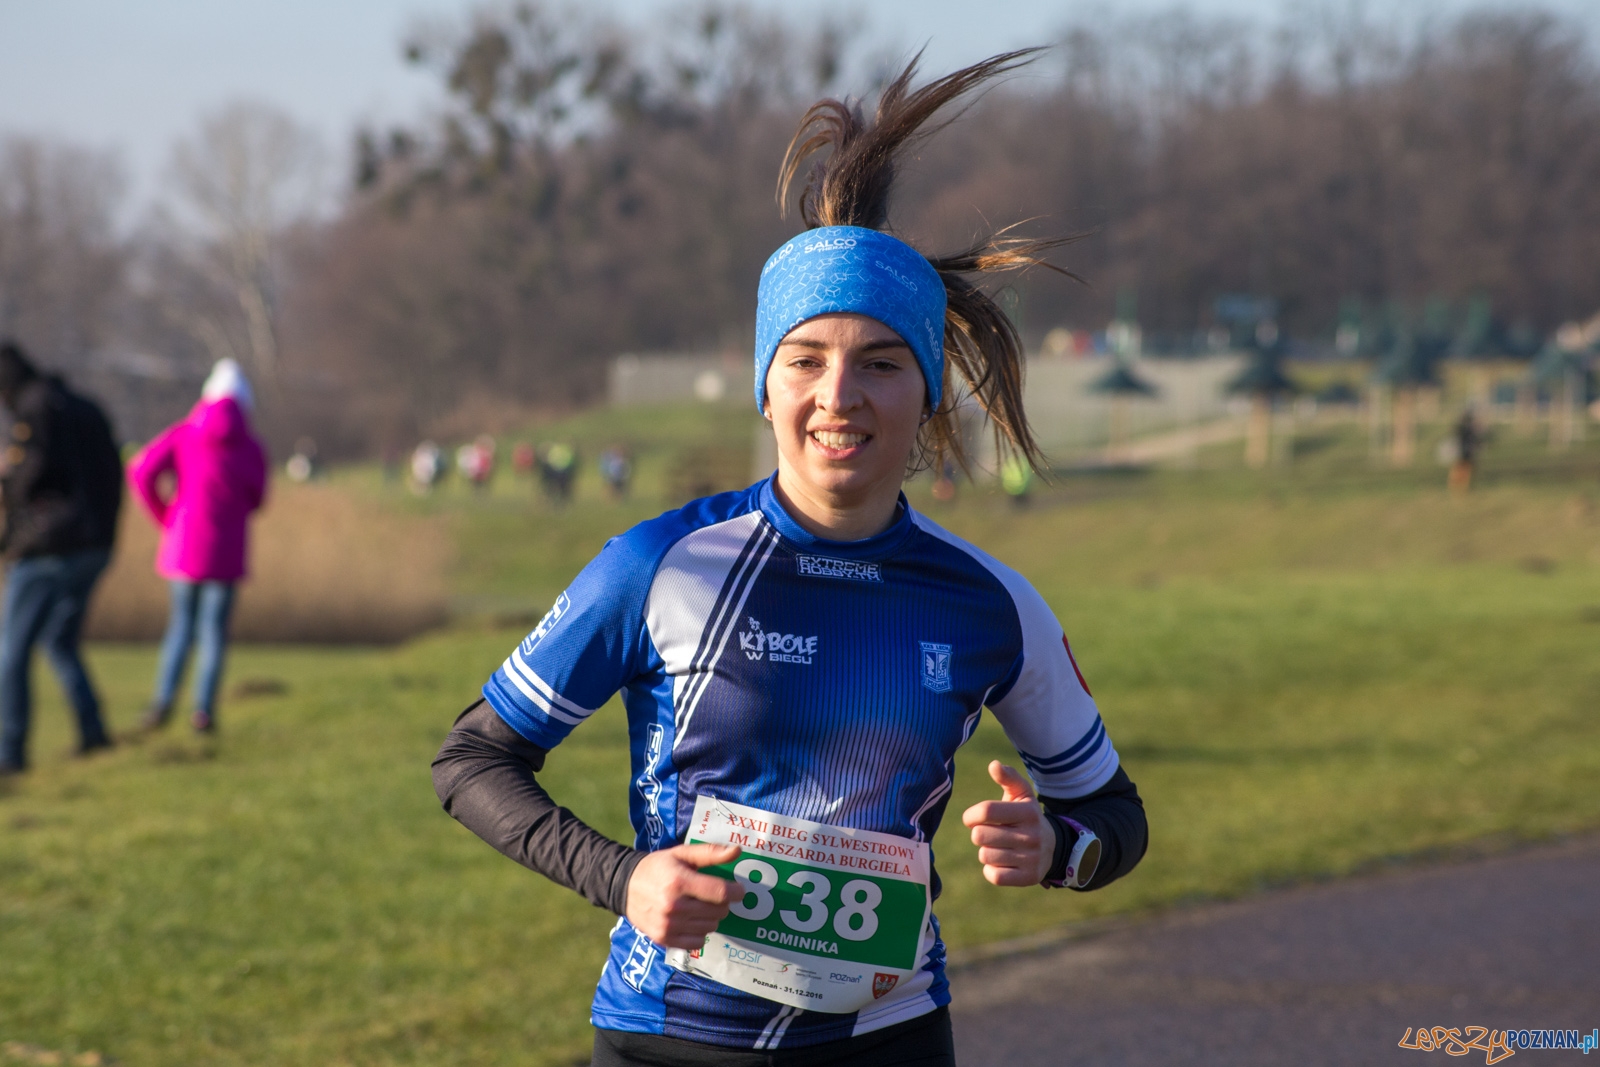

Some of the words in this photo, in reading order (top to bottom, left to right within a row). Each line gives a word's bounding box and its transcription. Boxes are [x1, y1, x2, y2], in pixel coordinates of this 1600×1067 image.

[764, 243, 795, 275] SALCO
[804, 238, 858, 254] SALCO
[875, 260, 919, 292] SALCO
[800, 556, 879, 575] EXTREME
[746, 651, 764, 661] W
[769, 653, 812, 665] BIEGU
[699, 823, 707, 835] 5,4
[703, 810, 711, 822] km
[726, 813, 769, 833] XXXII
[771, 823, 808, 842] BIEG
[812, 833, 915, 861] SYLWESTROWY
[729, 831, 751, 847] IM.
[755, 838, 836, 865] RYSZARDA
[839, 856, 911, 877] BURGIELA
[729, 858, 883, 942] 838
[756, 926, 839, 954] DOMINIKA
[783, 986, 823, 999] 31.12.2016
